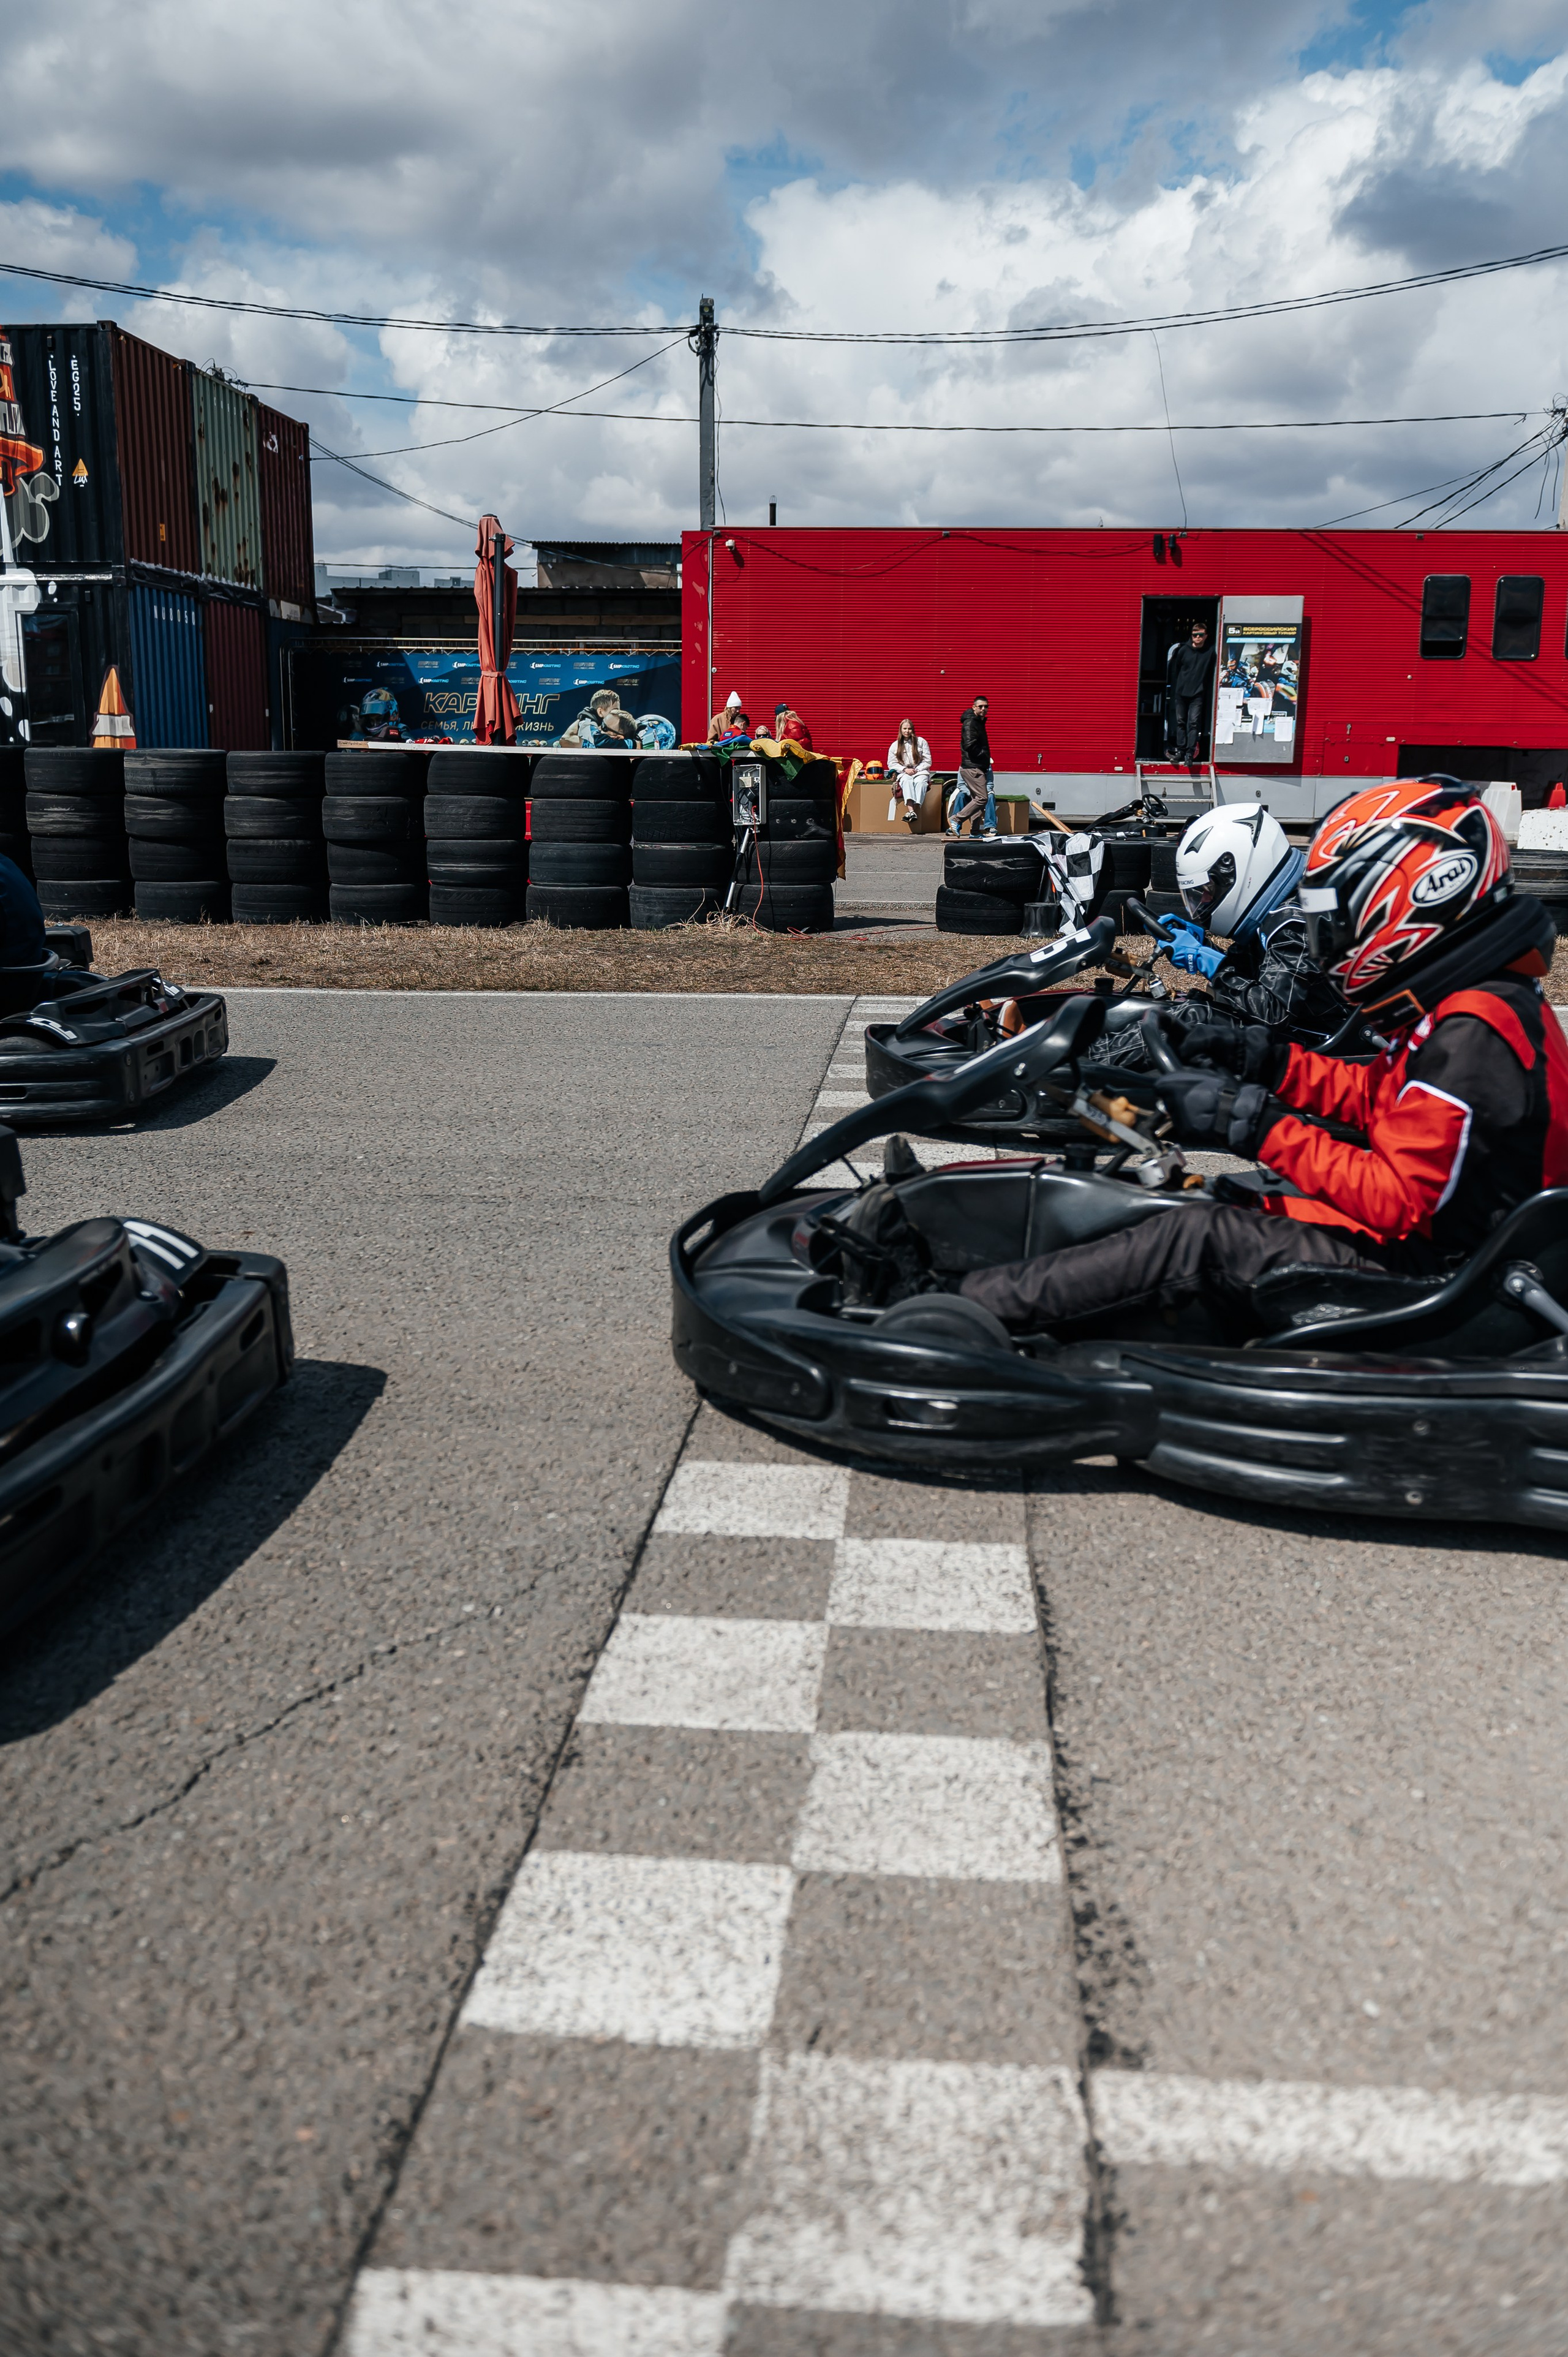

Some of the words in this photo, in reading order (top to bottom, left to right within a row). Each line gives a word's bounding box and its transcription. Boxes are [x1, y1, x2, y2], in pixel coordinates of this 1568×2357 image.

[51, 404, 60, 442] AND
[424, 693, 560, 714] КАРНГ
[421, 721, 459, 731] СЕМЬЯ,
[1427, 858, 1466, 892] Arai
